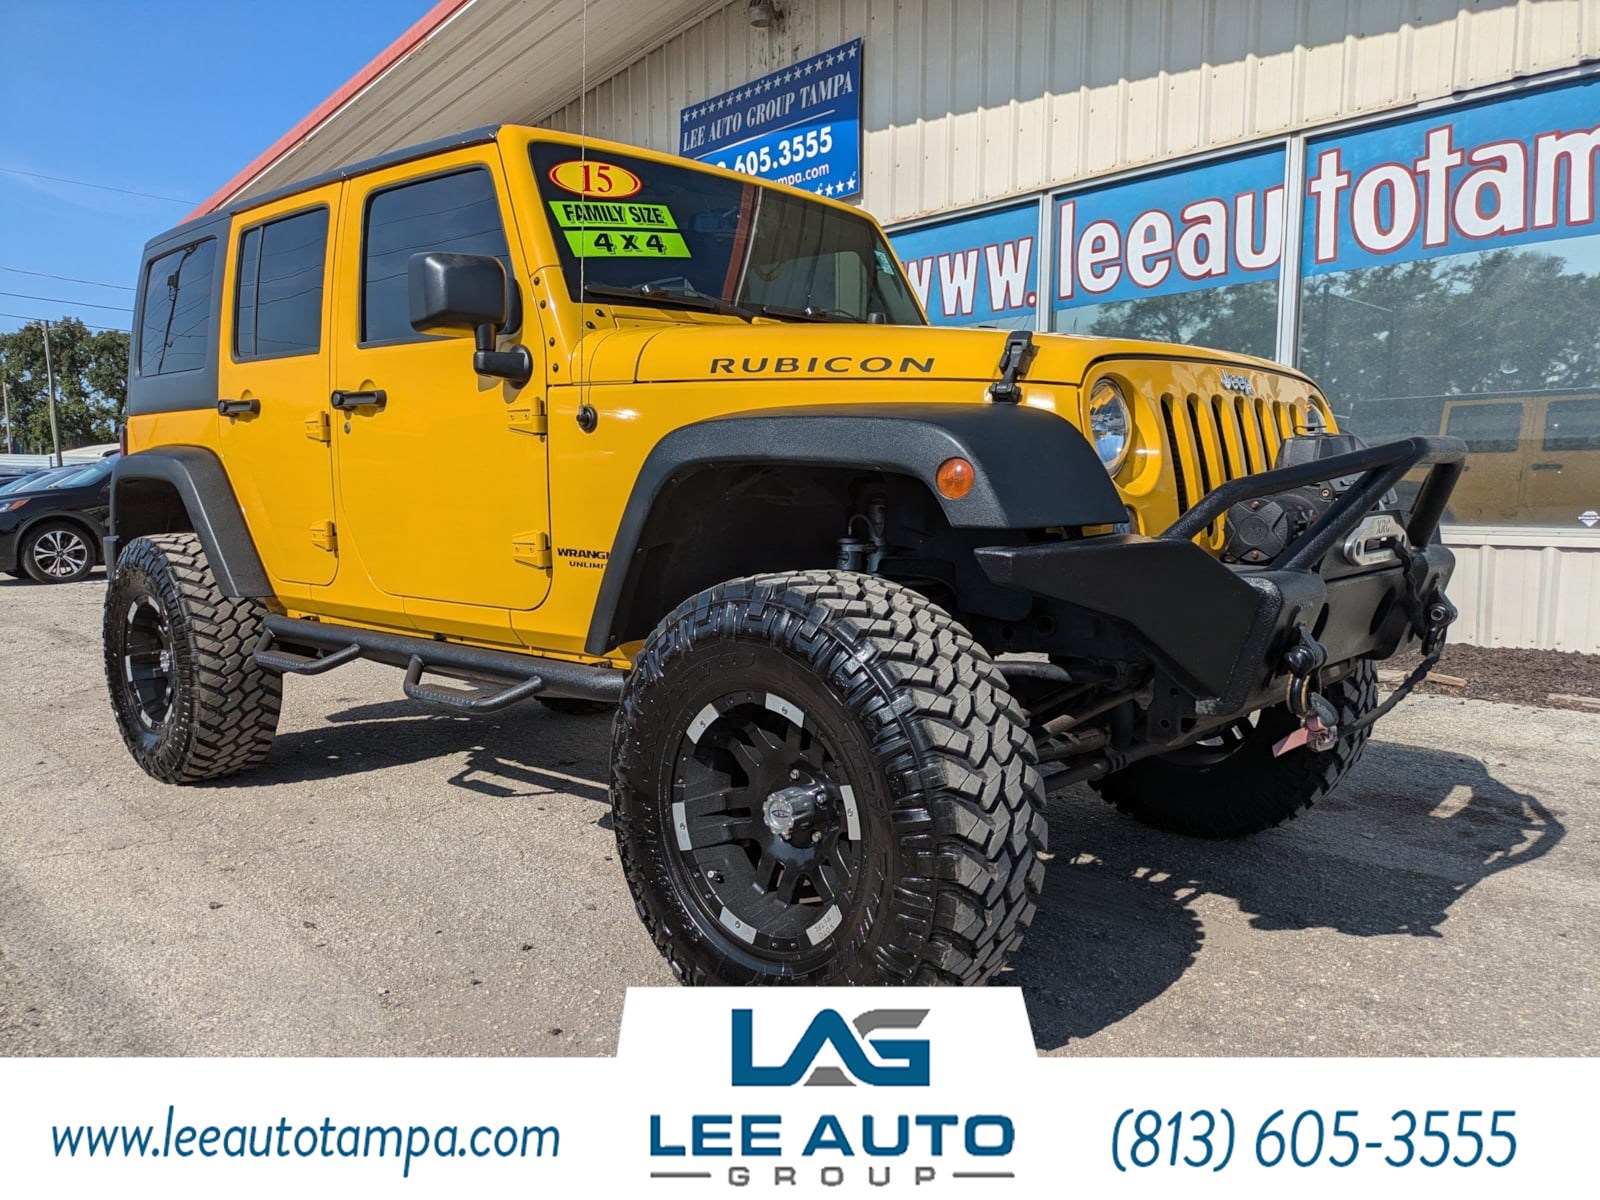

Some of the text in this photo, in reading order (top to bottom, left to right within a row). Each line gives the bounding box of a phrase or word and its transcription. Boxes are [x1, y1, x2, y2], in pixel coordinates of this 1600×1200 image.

[682, 70, 853, 152] LEE AUTO GROUP TAMPA
[580, 164, 613, 193] 15
[562, 203, 667, 226] FAMILY SIZE
[710, 356, 935, 374] RUBICON
